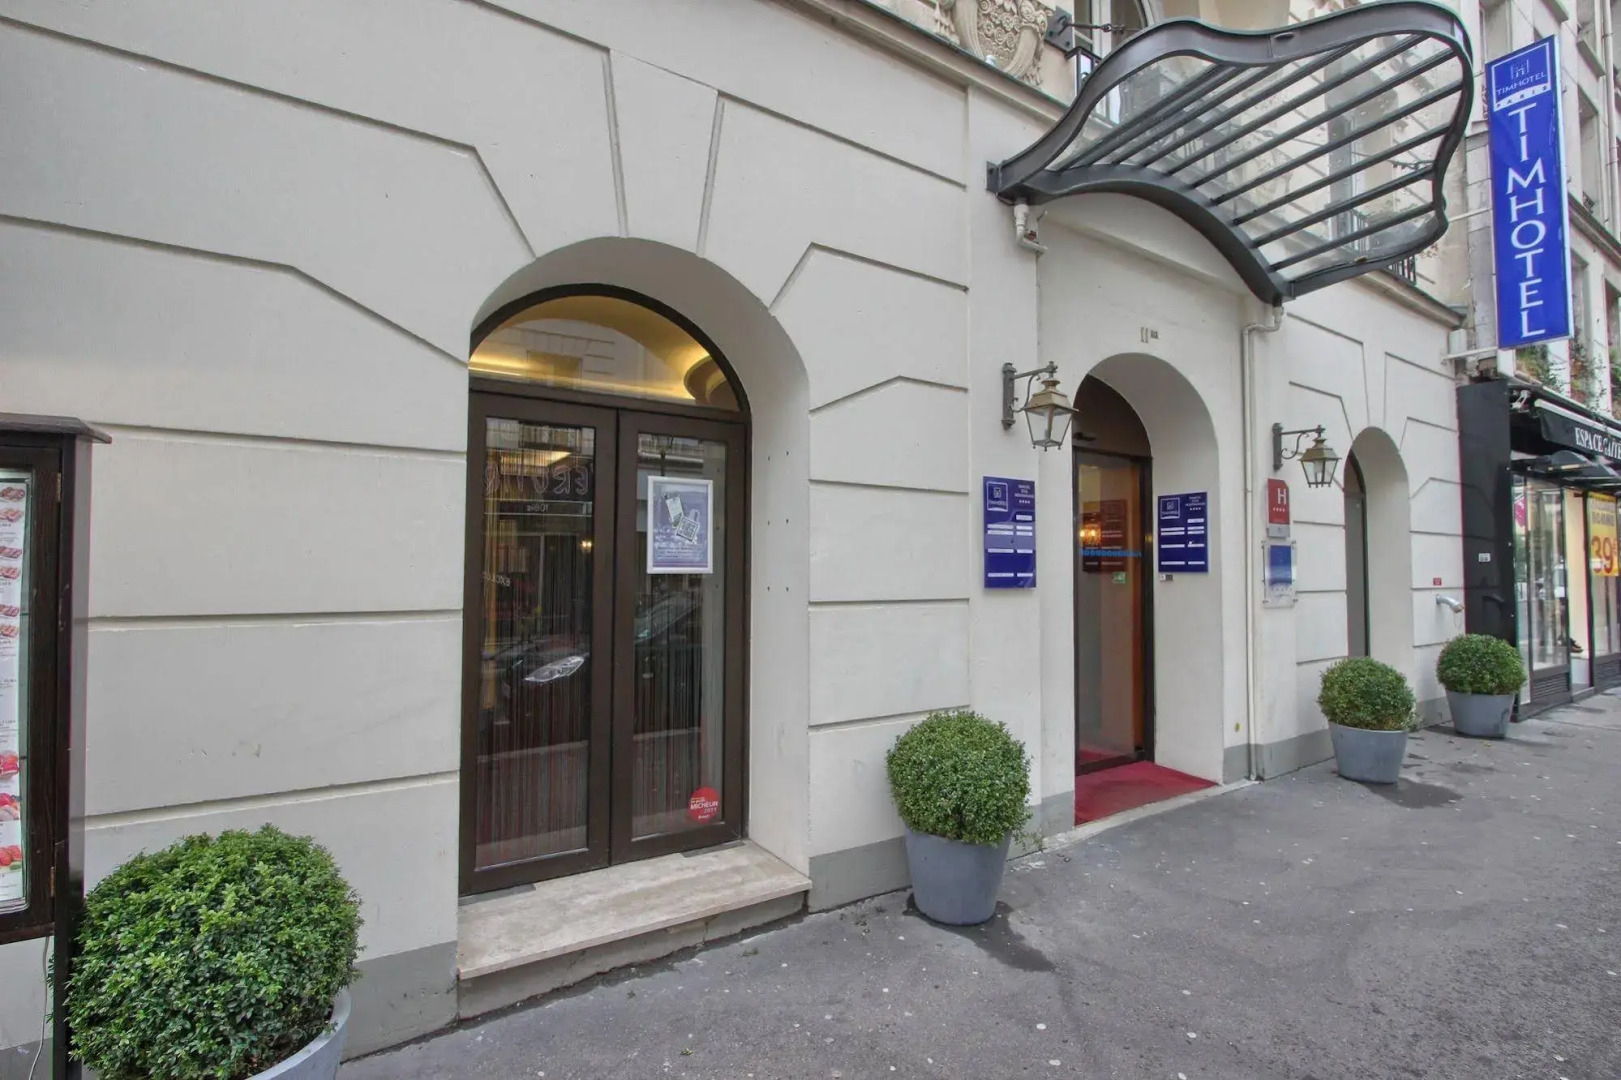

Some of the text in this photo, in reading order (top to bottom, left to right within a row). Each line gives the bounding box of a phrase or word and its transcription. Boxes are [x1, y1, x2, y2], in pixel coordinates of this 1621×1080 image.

[1496, 72, 1547, 95] TIMHOTEL
[1496, 86, 1548, 108] PARIS
[1505, 102, 1547, 338] TIMHOTEL
[1574, 427, 1604, 453] ESPACE
[1277, 487, 1287, 505] H
[690, 801, 719, 810] MICHELIN
